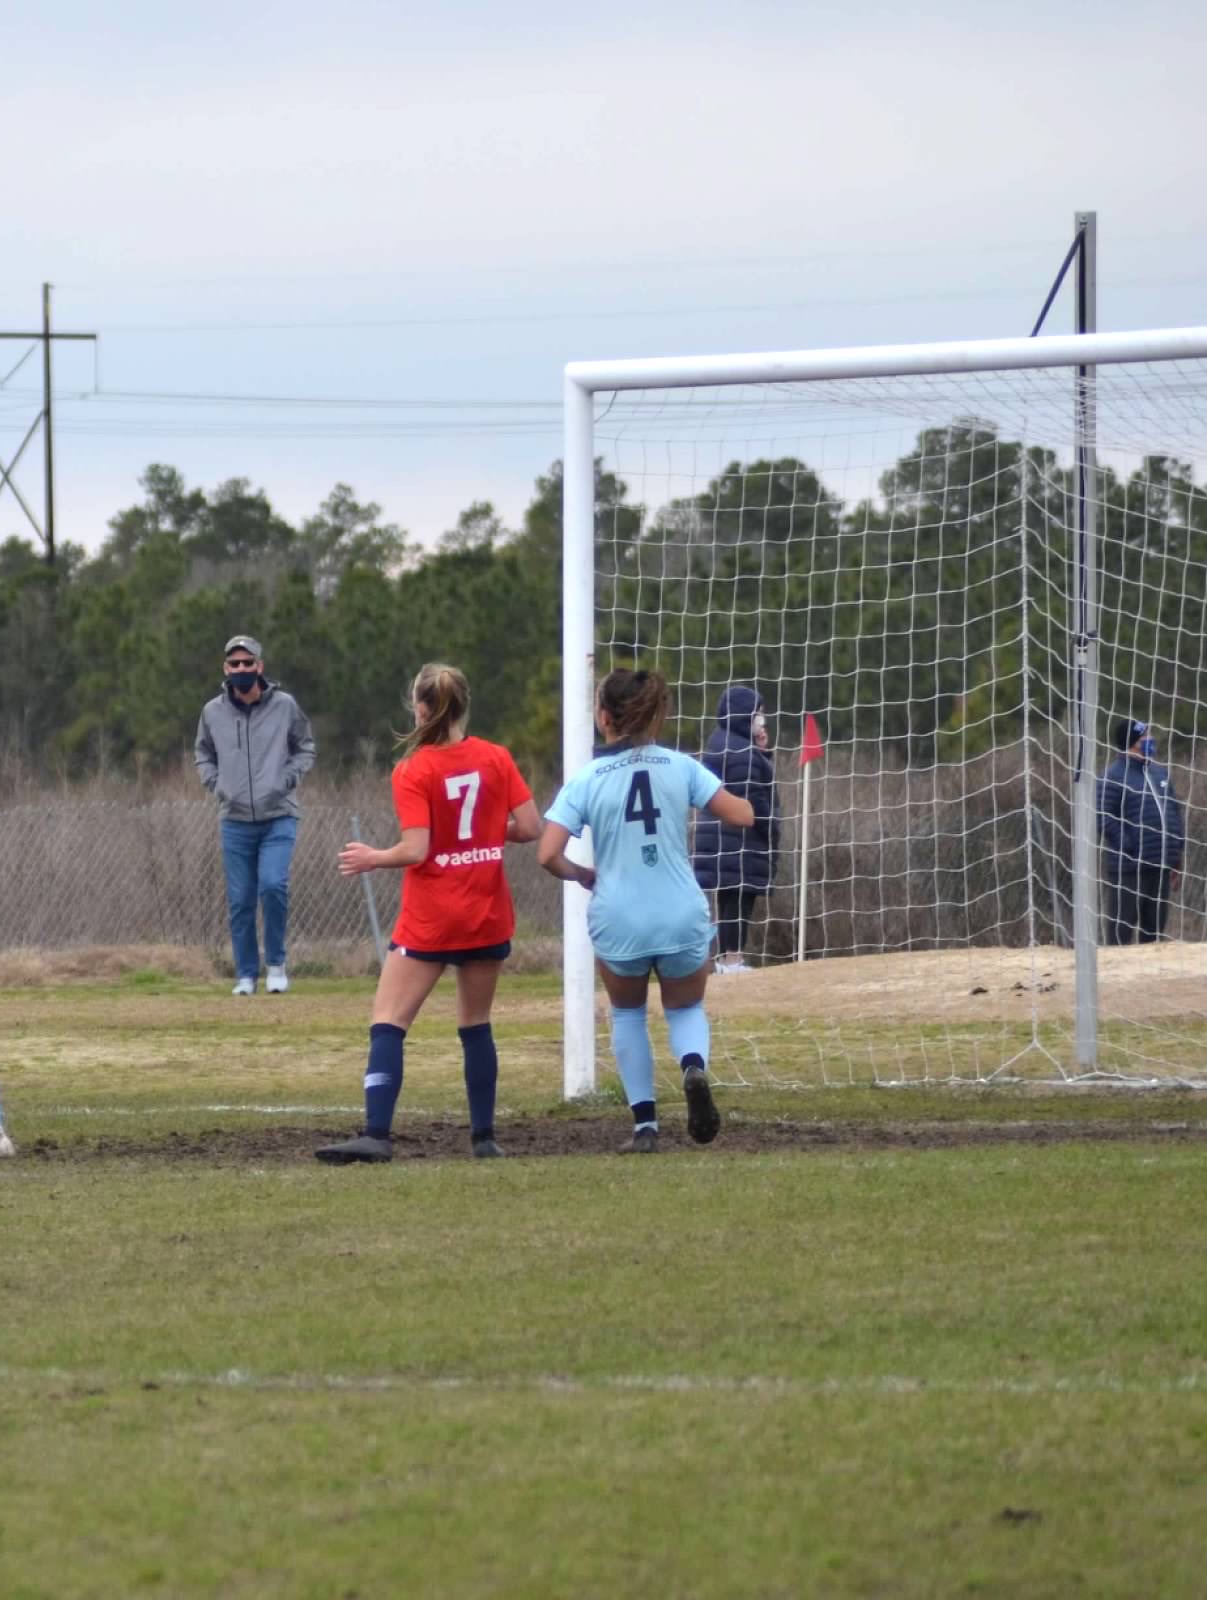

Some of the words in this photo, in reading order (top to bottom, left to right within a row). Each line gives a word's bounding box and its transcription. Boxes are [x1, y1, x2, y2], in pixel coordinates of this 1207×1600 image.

[444, 770, 480, 841] 7
[625, 769, 661, 835] 4
[450, 846, 502, 866] aetna
